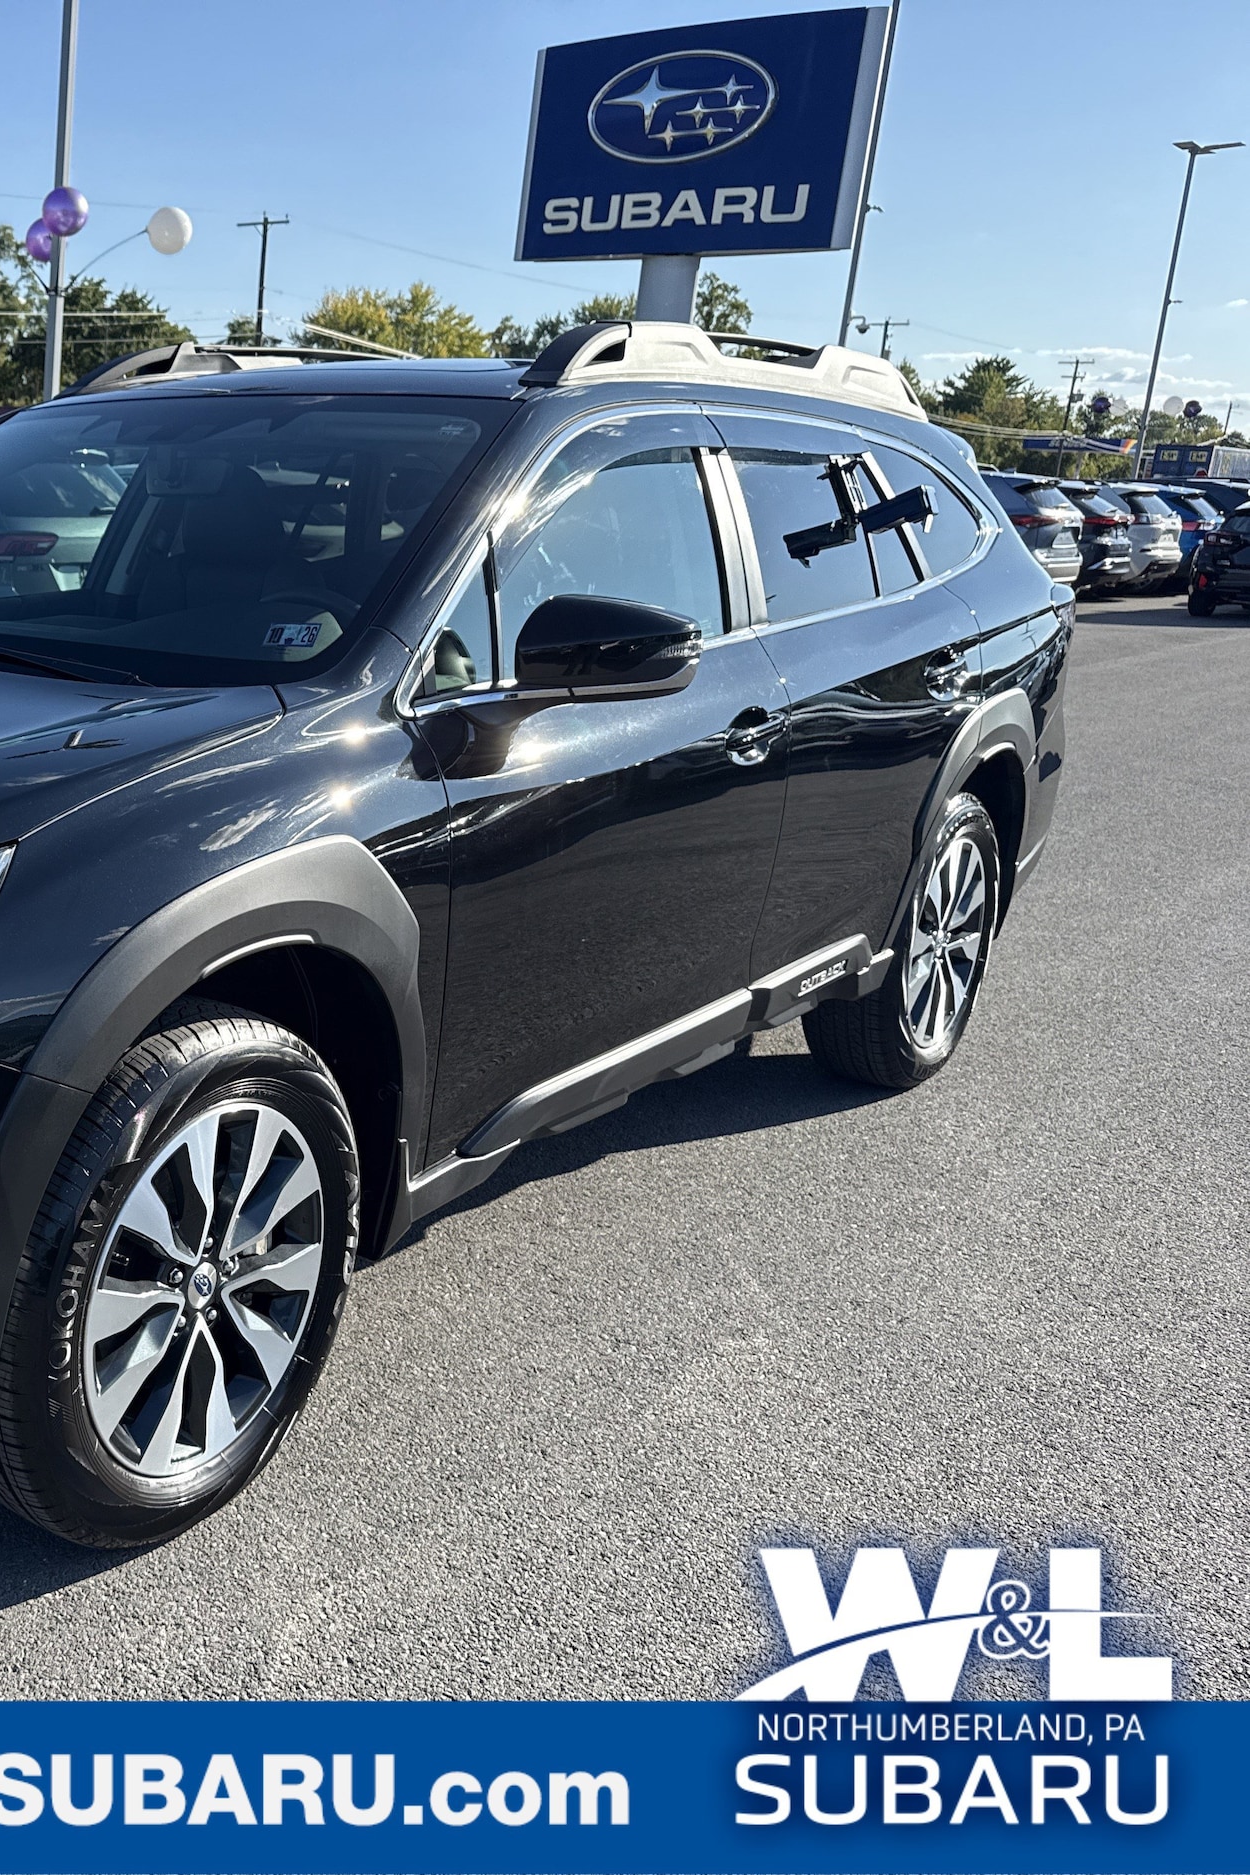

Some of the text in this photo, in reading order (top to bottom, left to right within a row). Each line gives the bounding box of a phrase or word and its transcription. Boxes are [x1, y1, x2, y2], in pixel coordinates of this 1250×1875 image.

[543, 184, 810, 235] SUBARU
[300, 626, 318, 643] 26
[799, 959, 847, 992] OUTBACK
